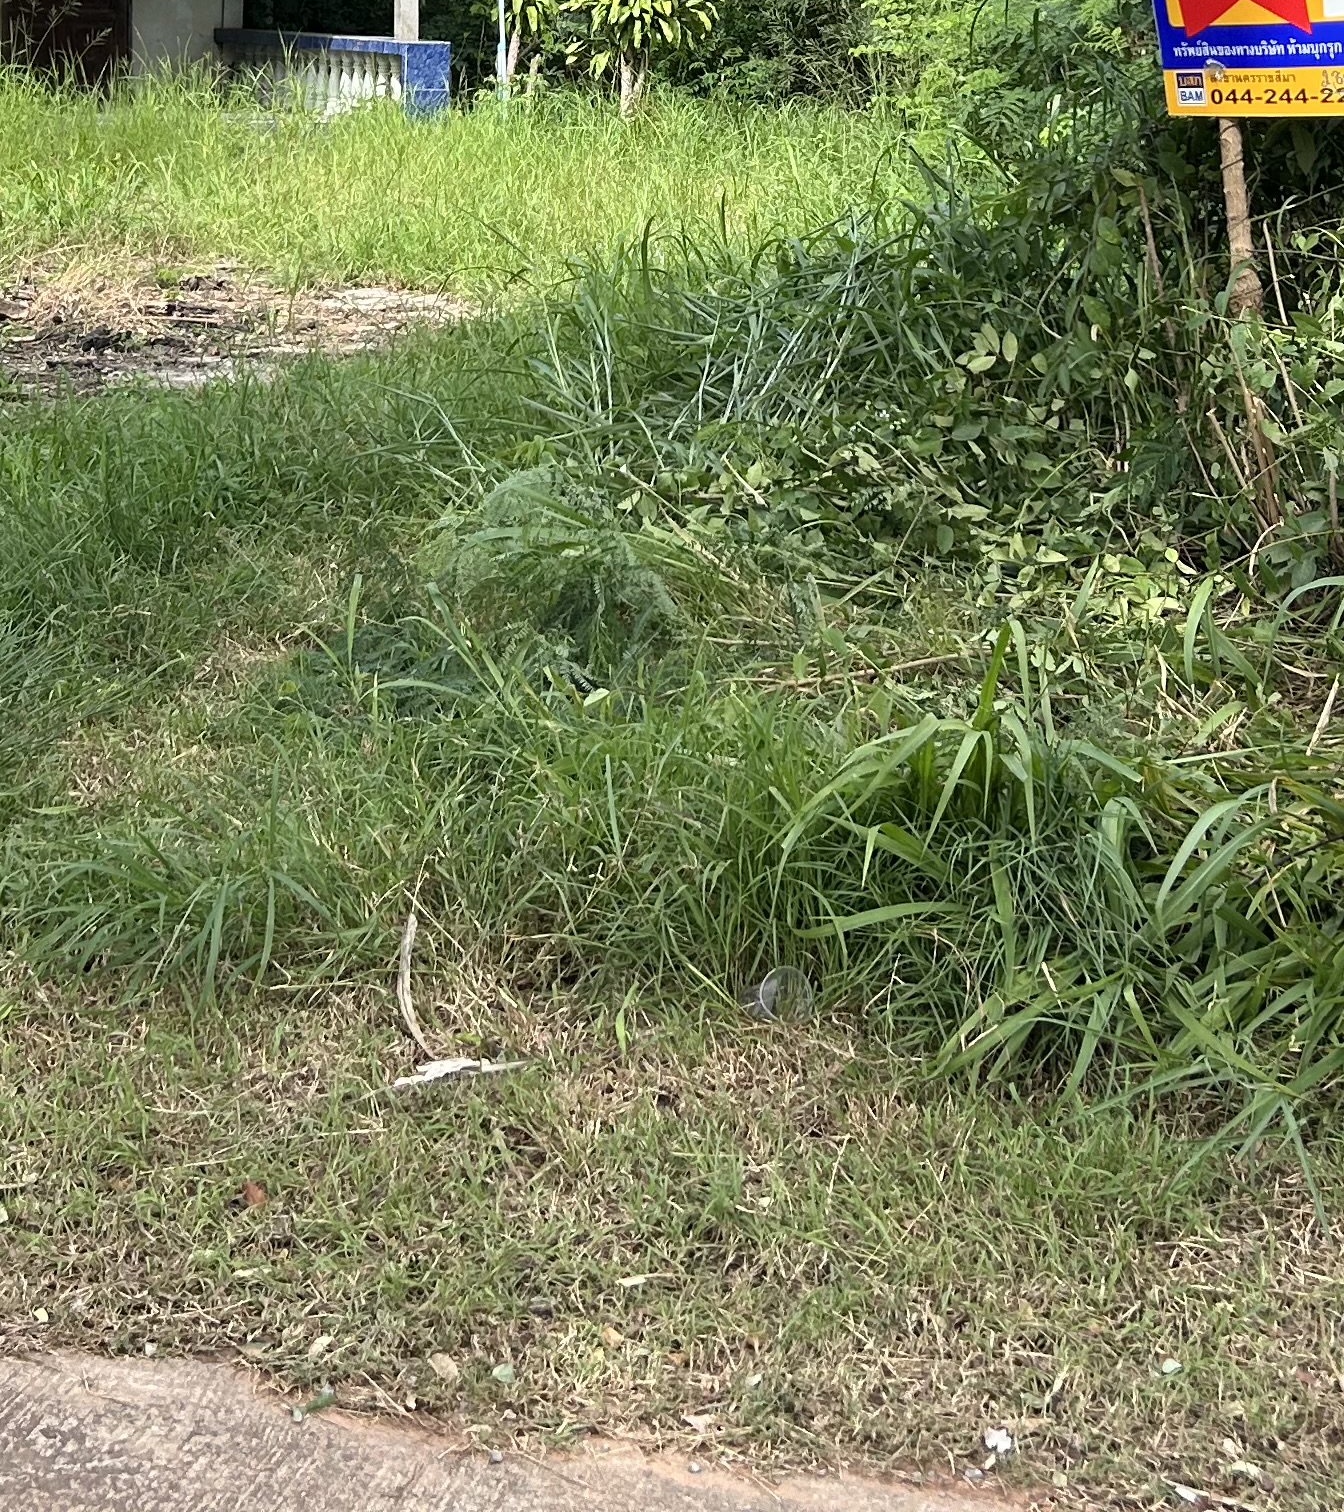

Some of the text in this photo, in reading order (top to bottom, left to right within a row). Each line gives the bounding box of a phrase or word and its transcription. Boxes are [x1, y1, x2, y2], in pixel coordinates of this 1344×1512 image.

[1173, 39, 1285, 58] ทรัพย์สินของทางบริษัท
[1287, 37, 1342, 60] ห้ามบุกรุก
[1180, 90, 1203, 102] BAM
